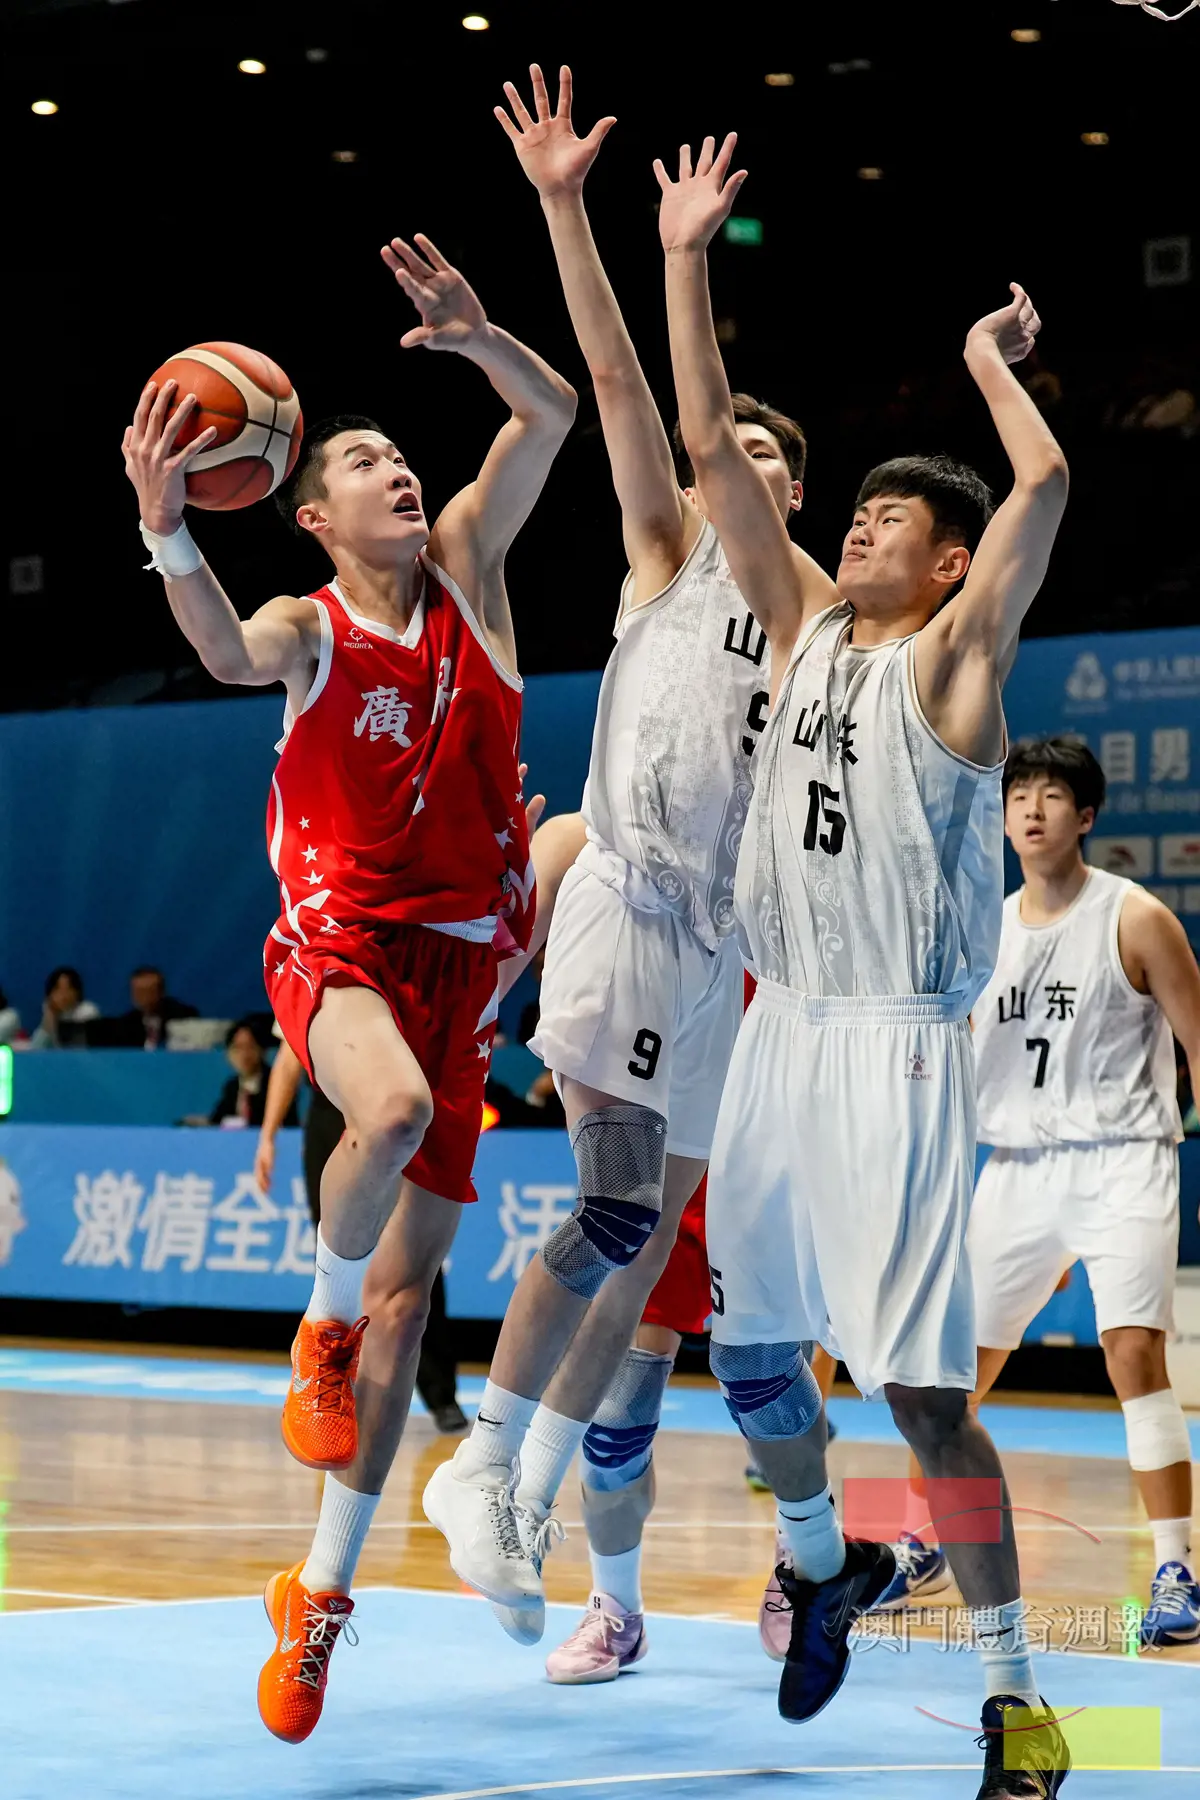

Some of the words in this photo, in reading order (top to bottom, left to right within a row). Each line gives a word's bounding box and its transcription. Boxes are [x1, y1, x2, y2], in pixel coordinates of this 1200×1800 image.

[803, 779, 847, 857] 15
[998, 980, 1076, 1023] 山东
[627, 1028, 662, 1080] 9
[904, 1073, 933, 1081] KELME
[1026, 1038, 1050, 1088] 7
